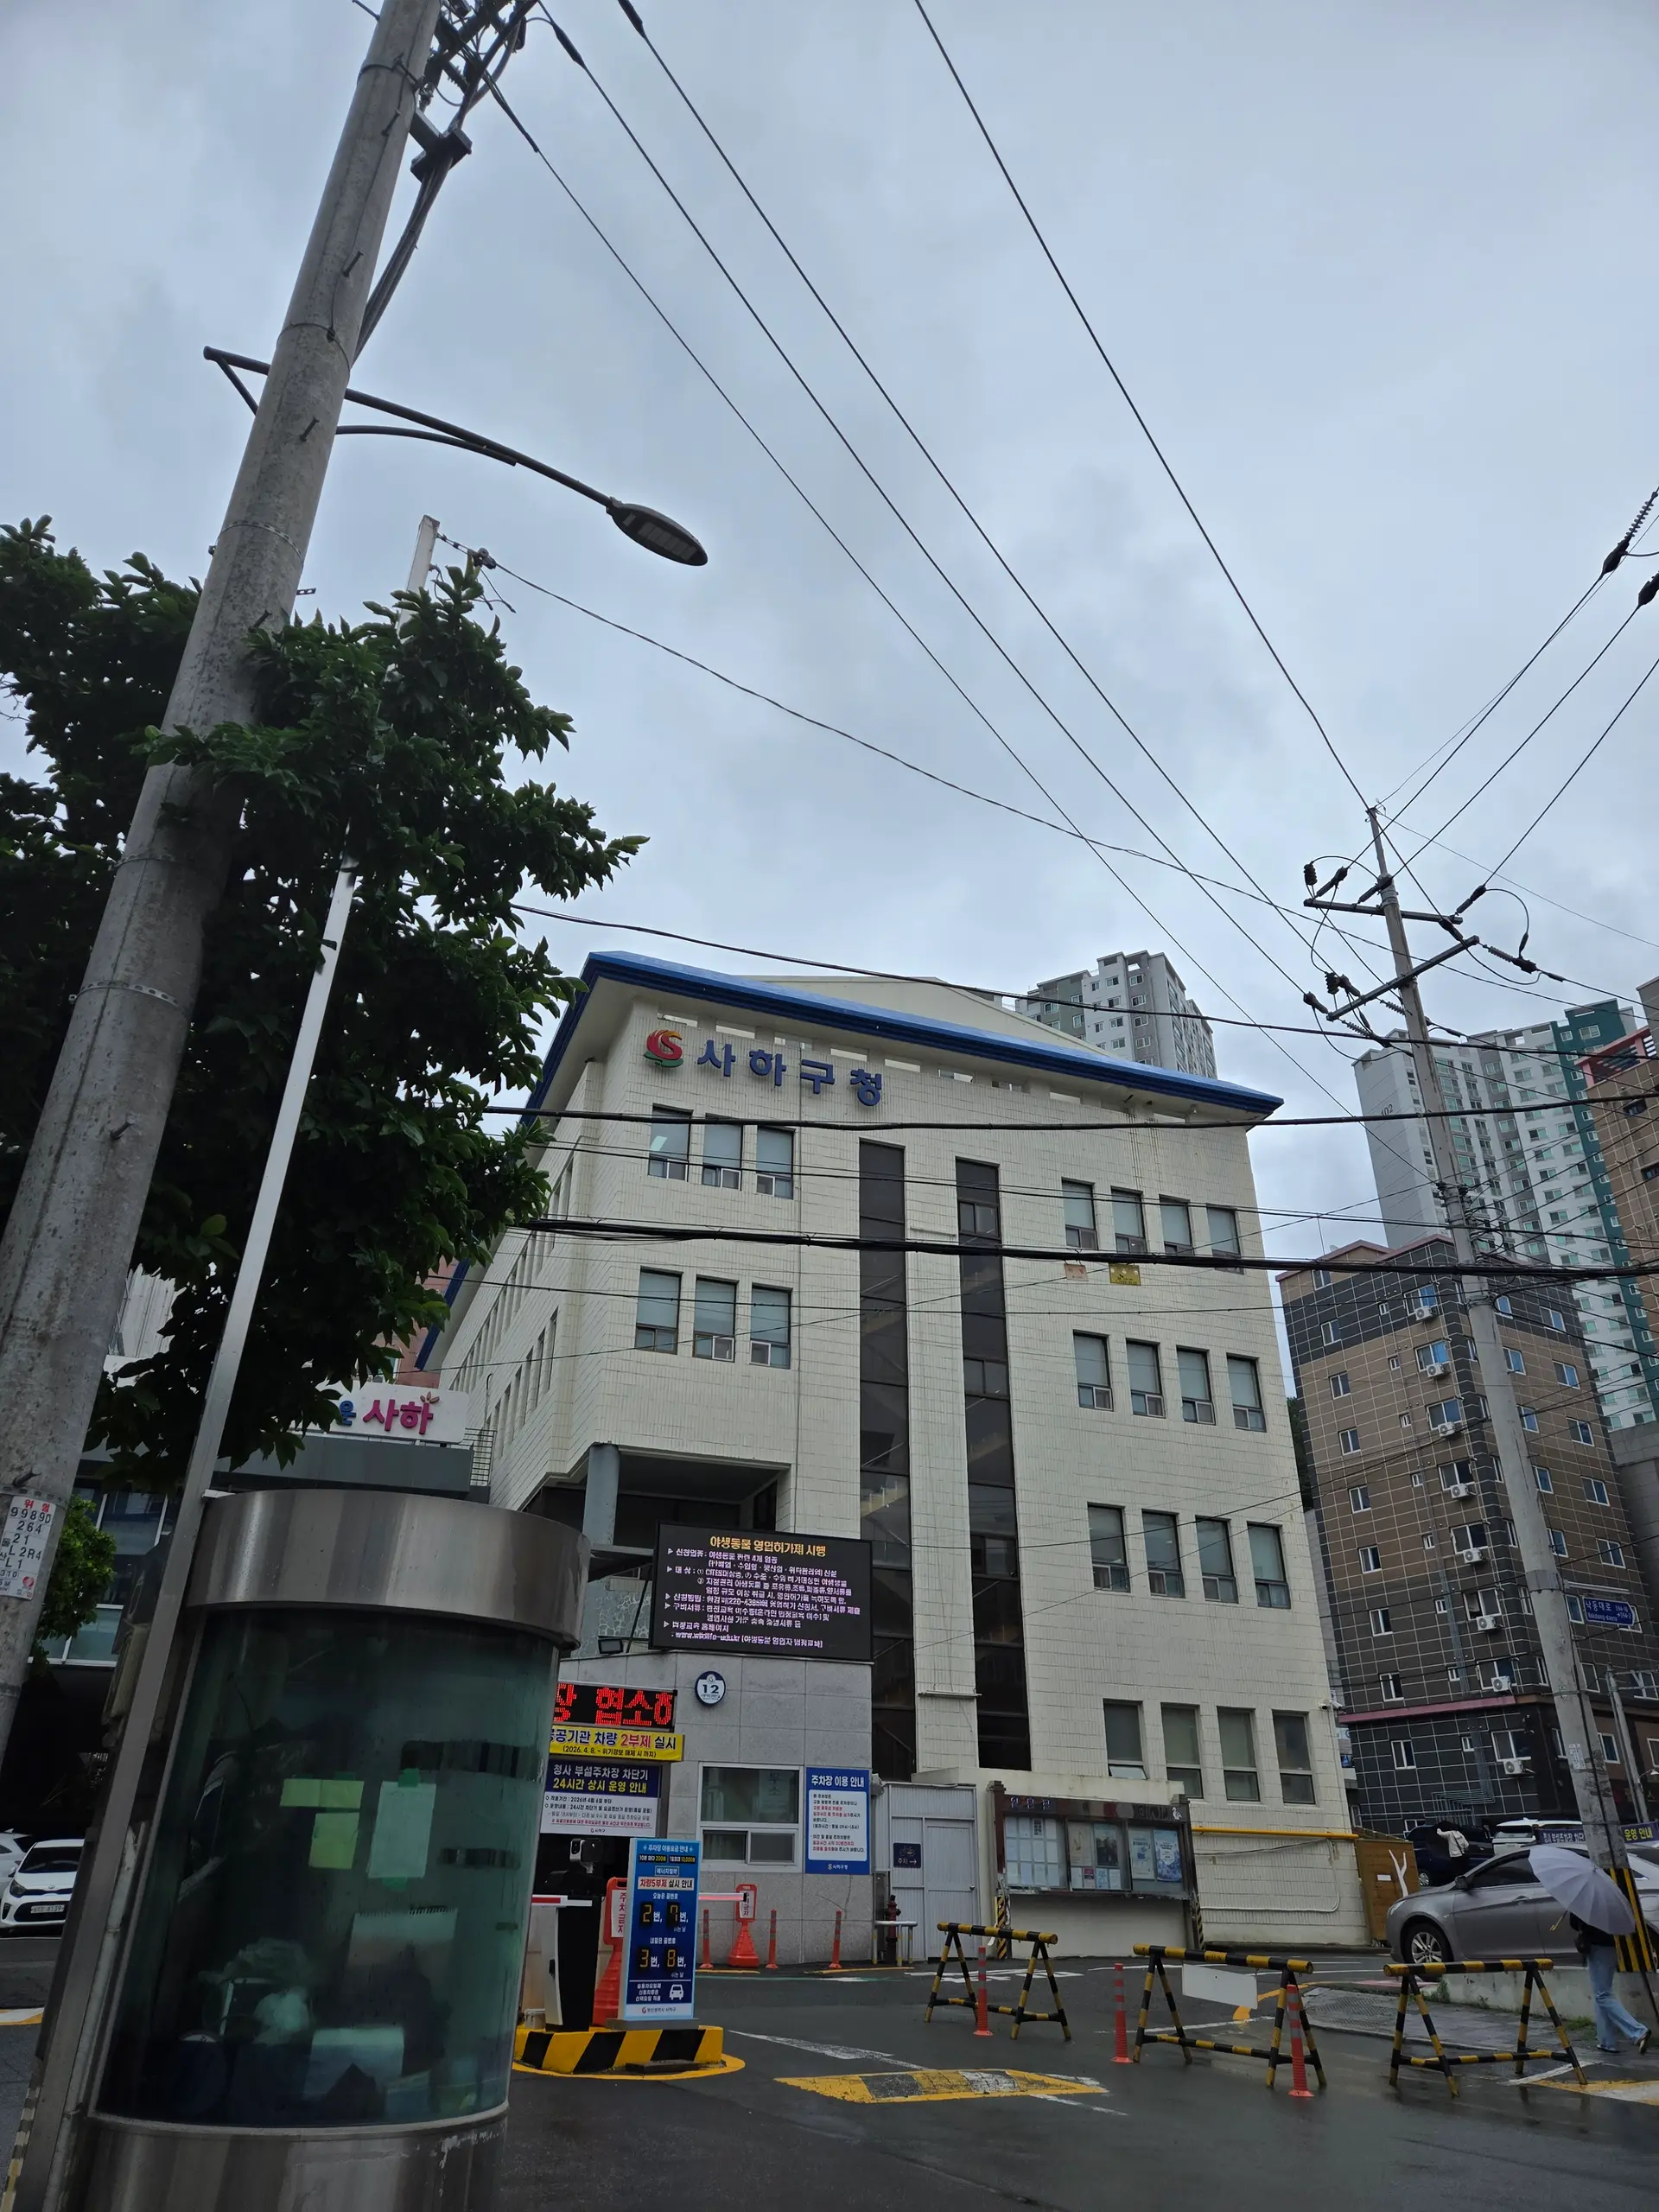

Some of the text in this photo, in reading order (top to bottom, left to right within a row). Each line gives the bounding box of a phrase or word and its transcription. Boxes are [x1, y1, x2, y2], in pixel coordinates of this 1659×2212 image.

[696, 1039, 882, 1107] 사하구청
[363, 1399, 434, 1435] 사하
[16, 1520, 42, 1535] 264
[12, 1533, 29, 1545] 21
[709, 1535, 827, 1558] 야생동물 영업허가제 시행
[1585, 1599, 1612, 1612] 낙동대로
[702, 1684, 719, 1694] 12
[550, 1728, 677, 1750] 공기관 차량 2부제 실시
[553, 1764, 649, 1781] 청사 부설주차장 차단기
[810, 1774, 865, 1788] 주차장 이용 안내
[552, 1777, 647, 1794] 24시간 상시 운영 안내
[1624, 1826, 1653, 1841] 운영 안내
[639, 1878, 693, 1889] 차량5부제 실시 안내
[643, 1904, 652, 1923] 2
[639, 1949, 650, 1968] 3
[667, 1949, 677, 1968] 8
